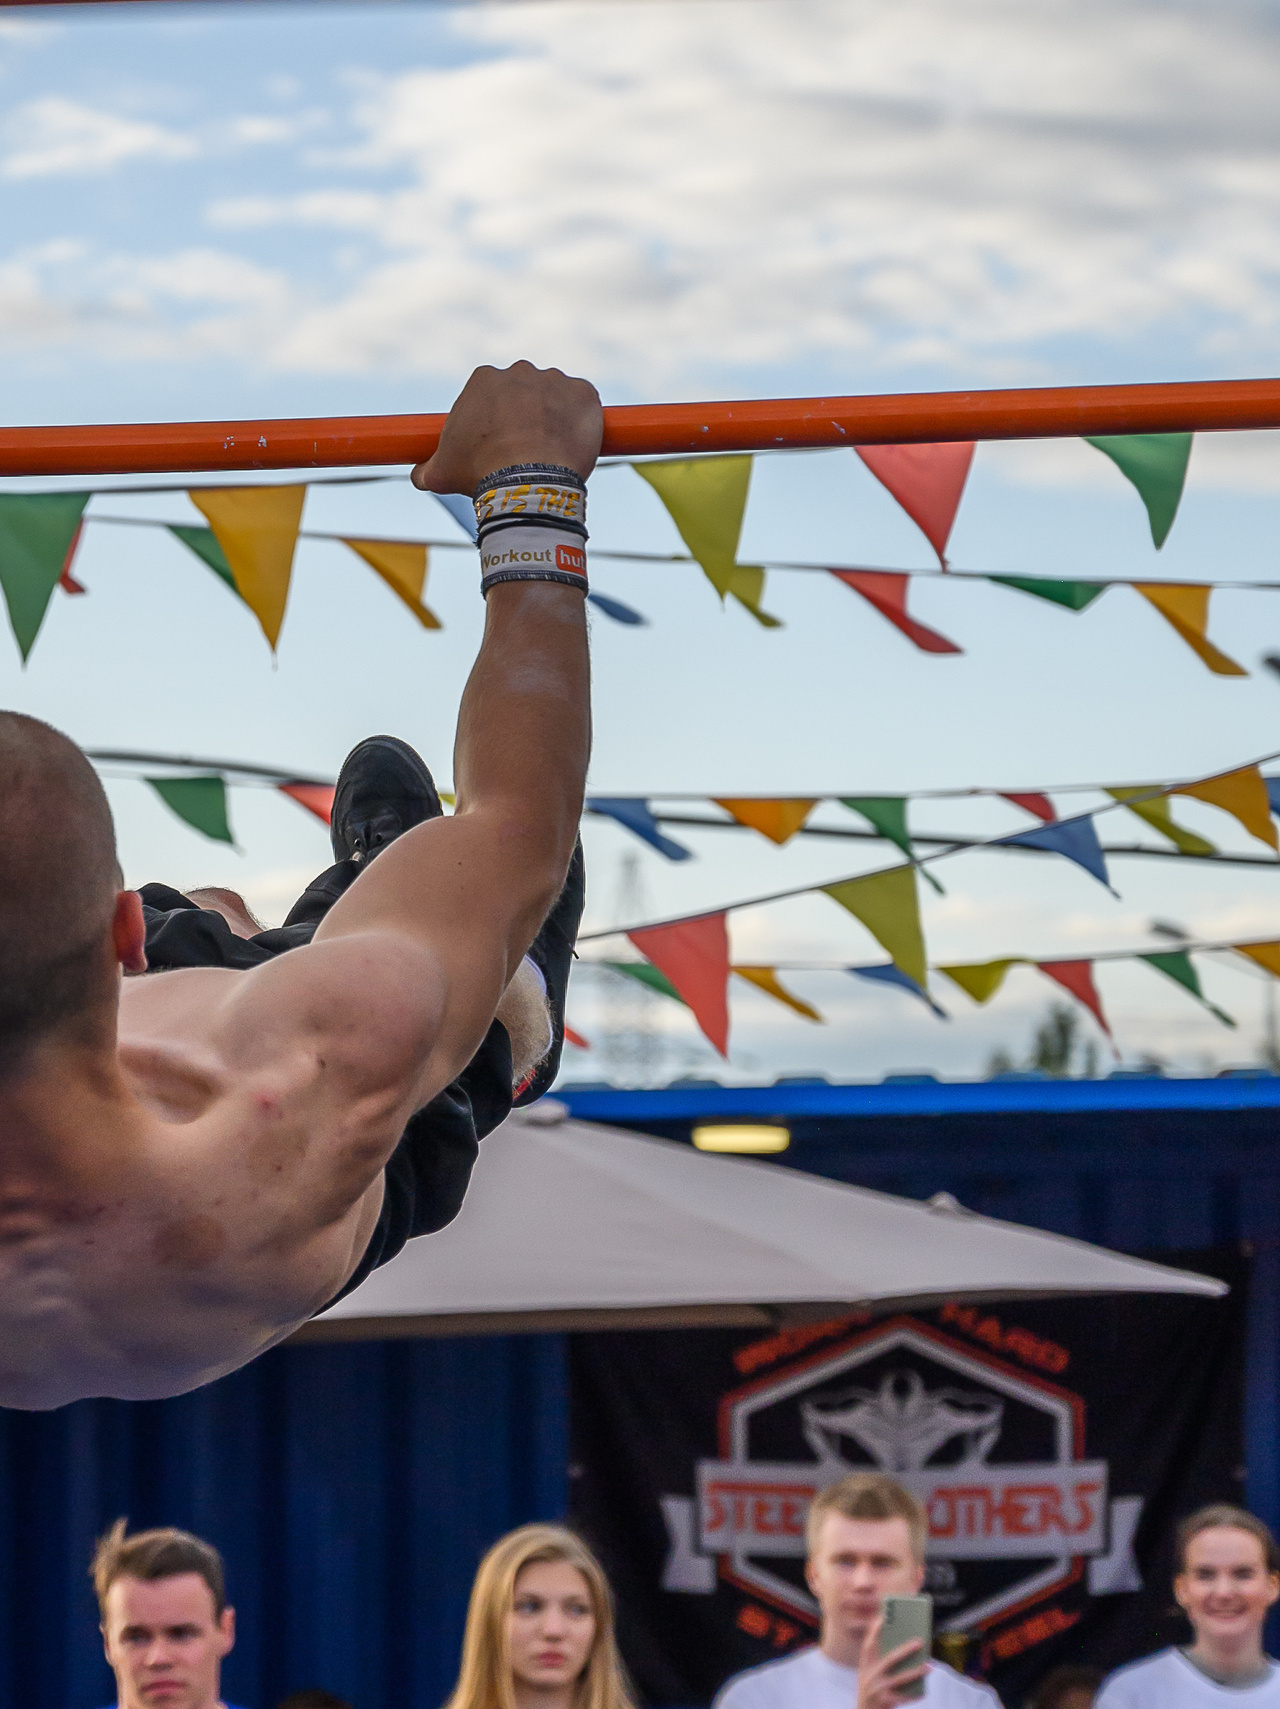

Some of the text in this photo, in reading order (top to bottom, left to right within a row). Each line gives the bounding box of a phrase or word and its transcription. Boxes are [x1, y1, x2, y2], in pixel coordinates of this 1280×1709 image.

[536, 487, 580, 516] THE
[707, 1482, 1100, 1537] STEE OTHERS
